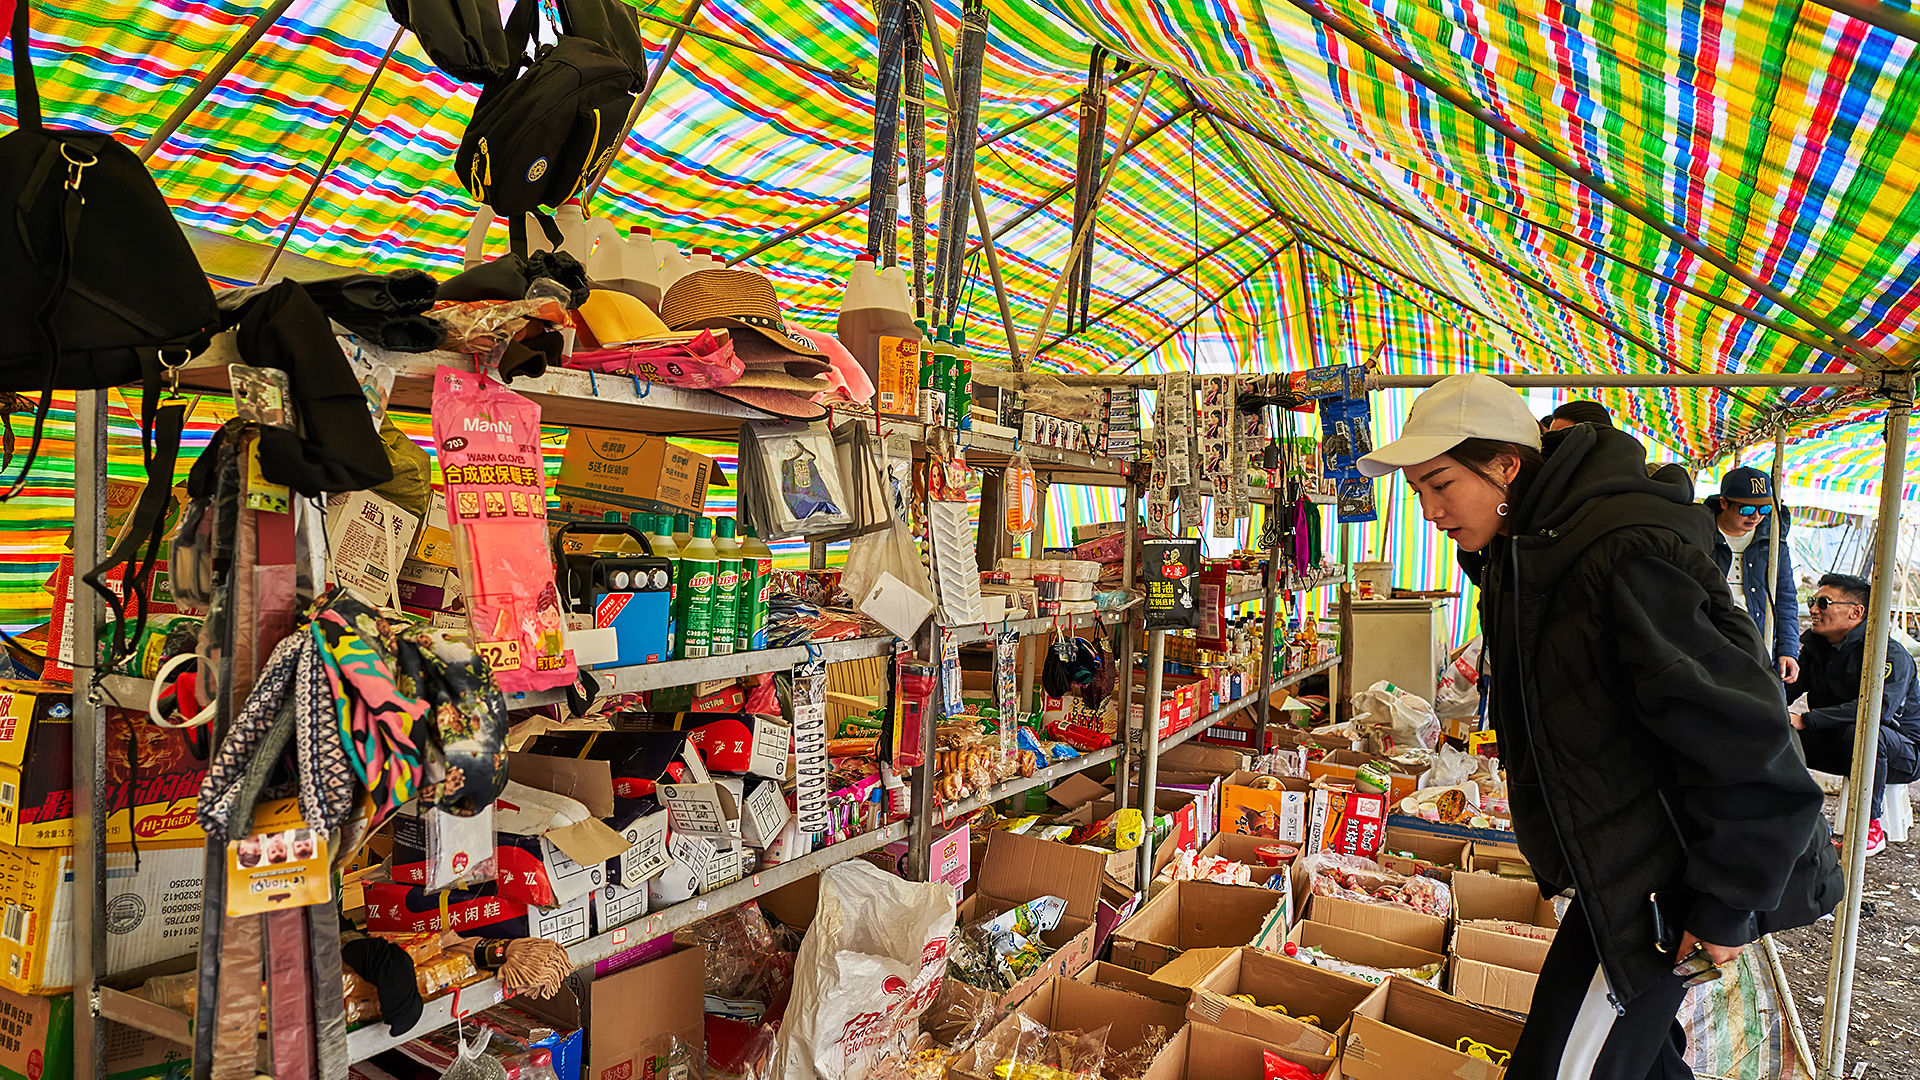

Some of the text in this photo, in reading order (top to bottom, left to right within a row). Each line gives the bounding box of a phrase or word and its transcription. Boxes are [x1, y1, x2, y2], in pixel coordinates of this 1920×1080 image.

[463, 416, 512, 435] ManNi
[446, 438, 464, 449] 703
[467, 453, 526, 464] WARM GLOVES
[1750, 477, 1767, 495] N
[140, 814, 193, 833] HI-TIGER
[165, 914, 201, 926] 6677785
[412, 901, 501, 932] 运动休闲鞋
[163, 926, 199, 938] 3611416
